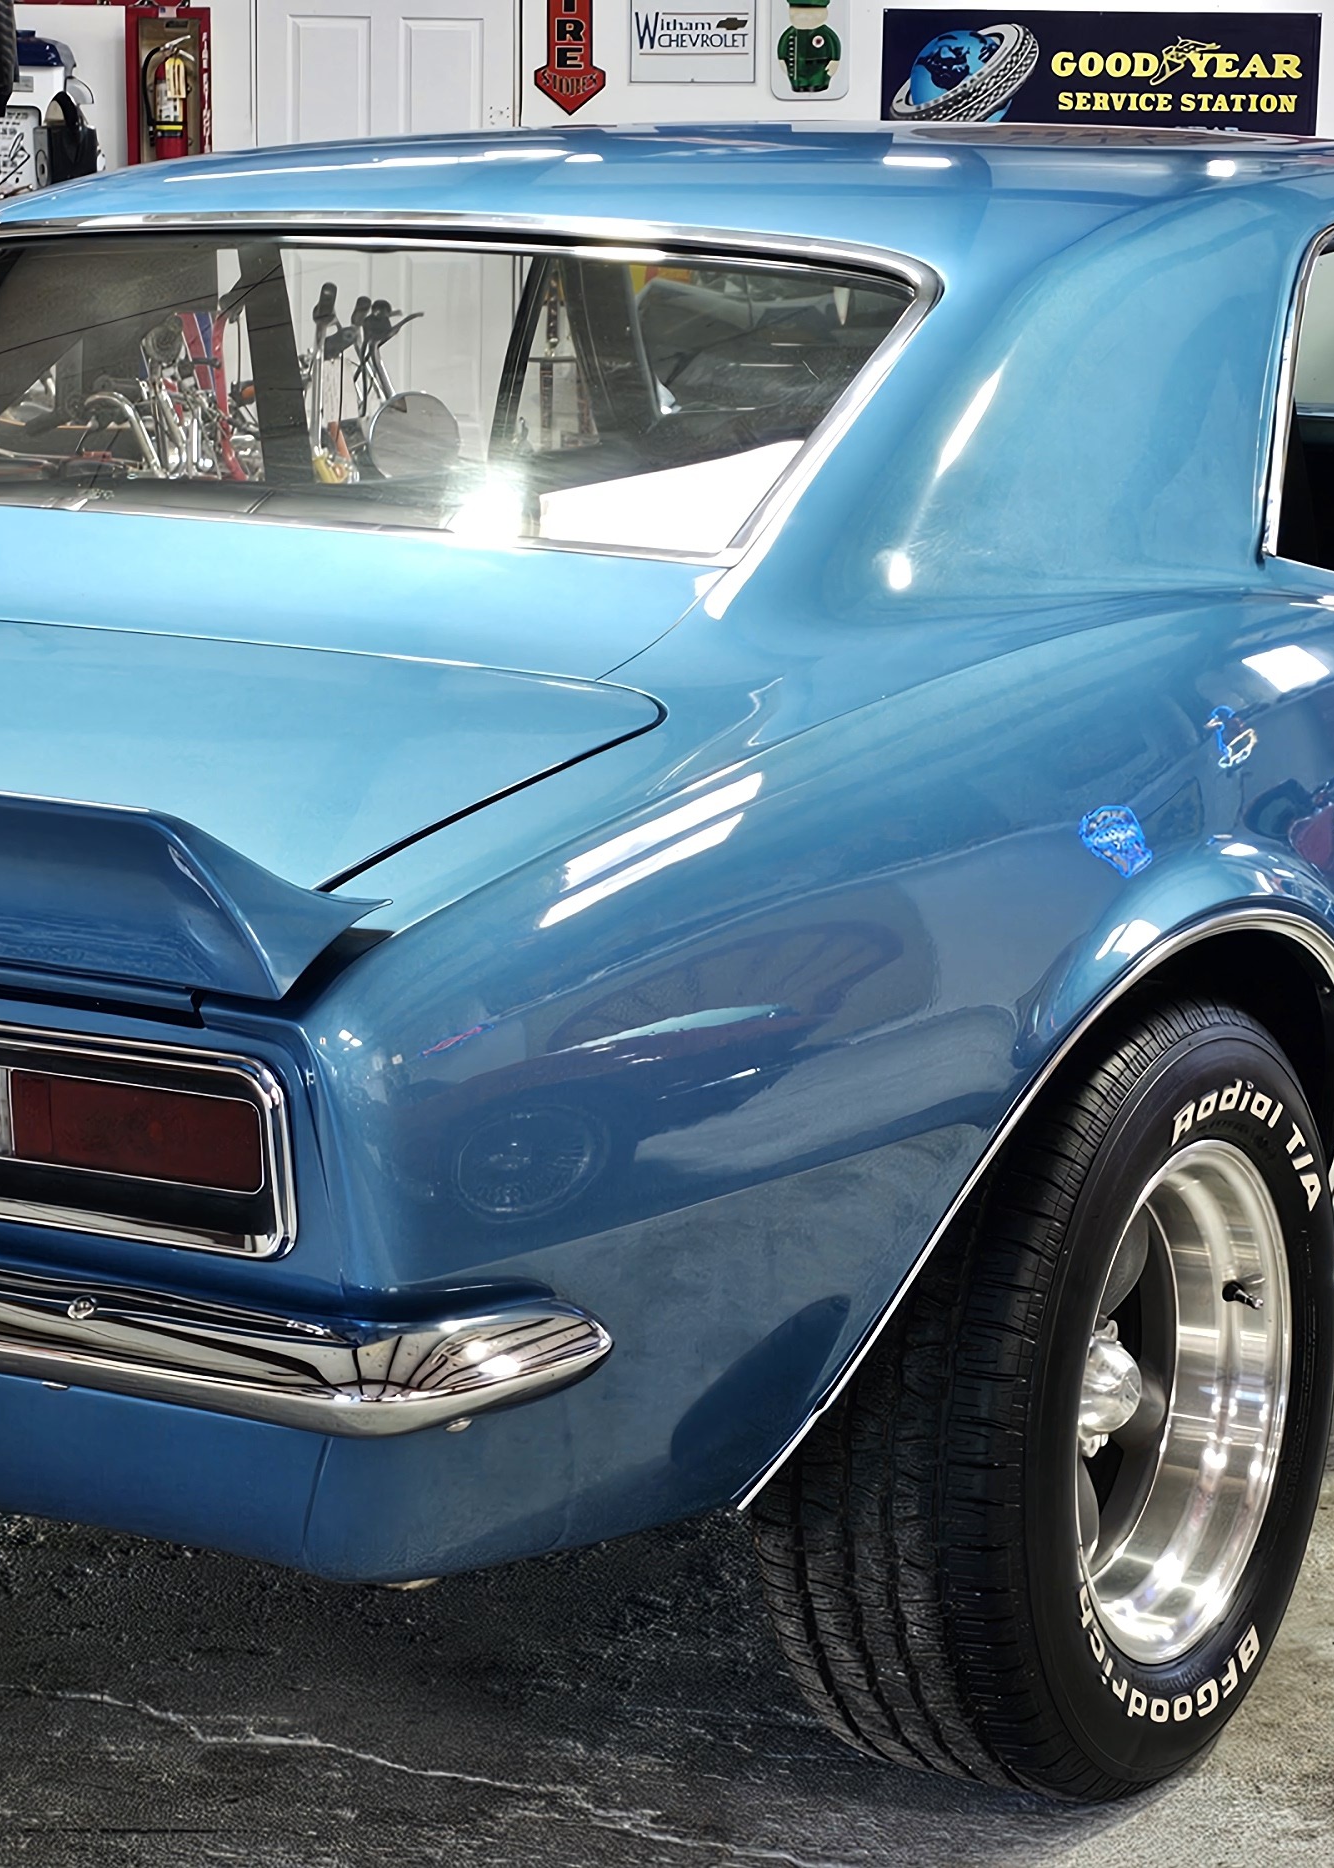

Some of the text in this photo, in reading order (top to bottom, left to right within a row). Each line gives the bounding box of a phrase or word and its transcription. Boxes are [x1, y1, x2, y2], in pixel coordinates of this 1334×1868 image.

[635, 11, 712, 50] Witham
[656, 33, 749, 49] CHEVROLET
[1057, 91, 1298, 113] SERVICE STATION
[1171, 1078, 1284, 1147] Radial
[1079, 1582, 1260, 1723] BFGoodrich
